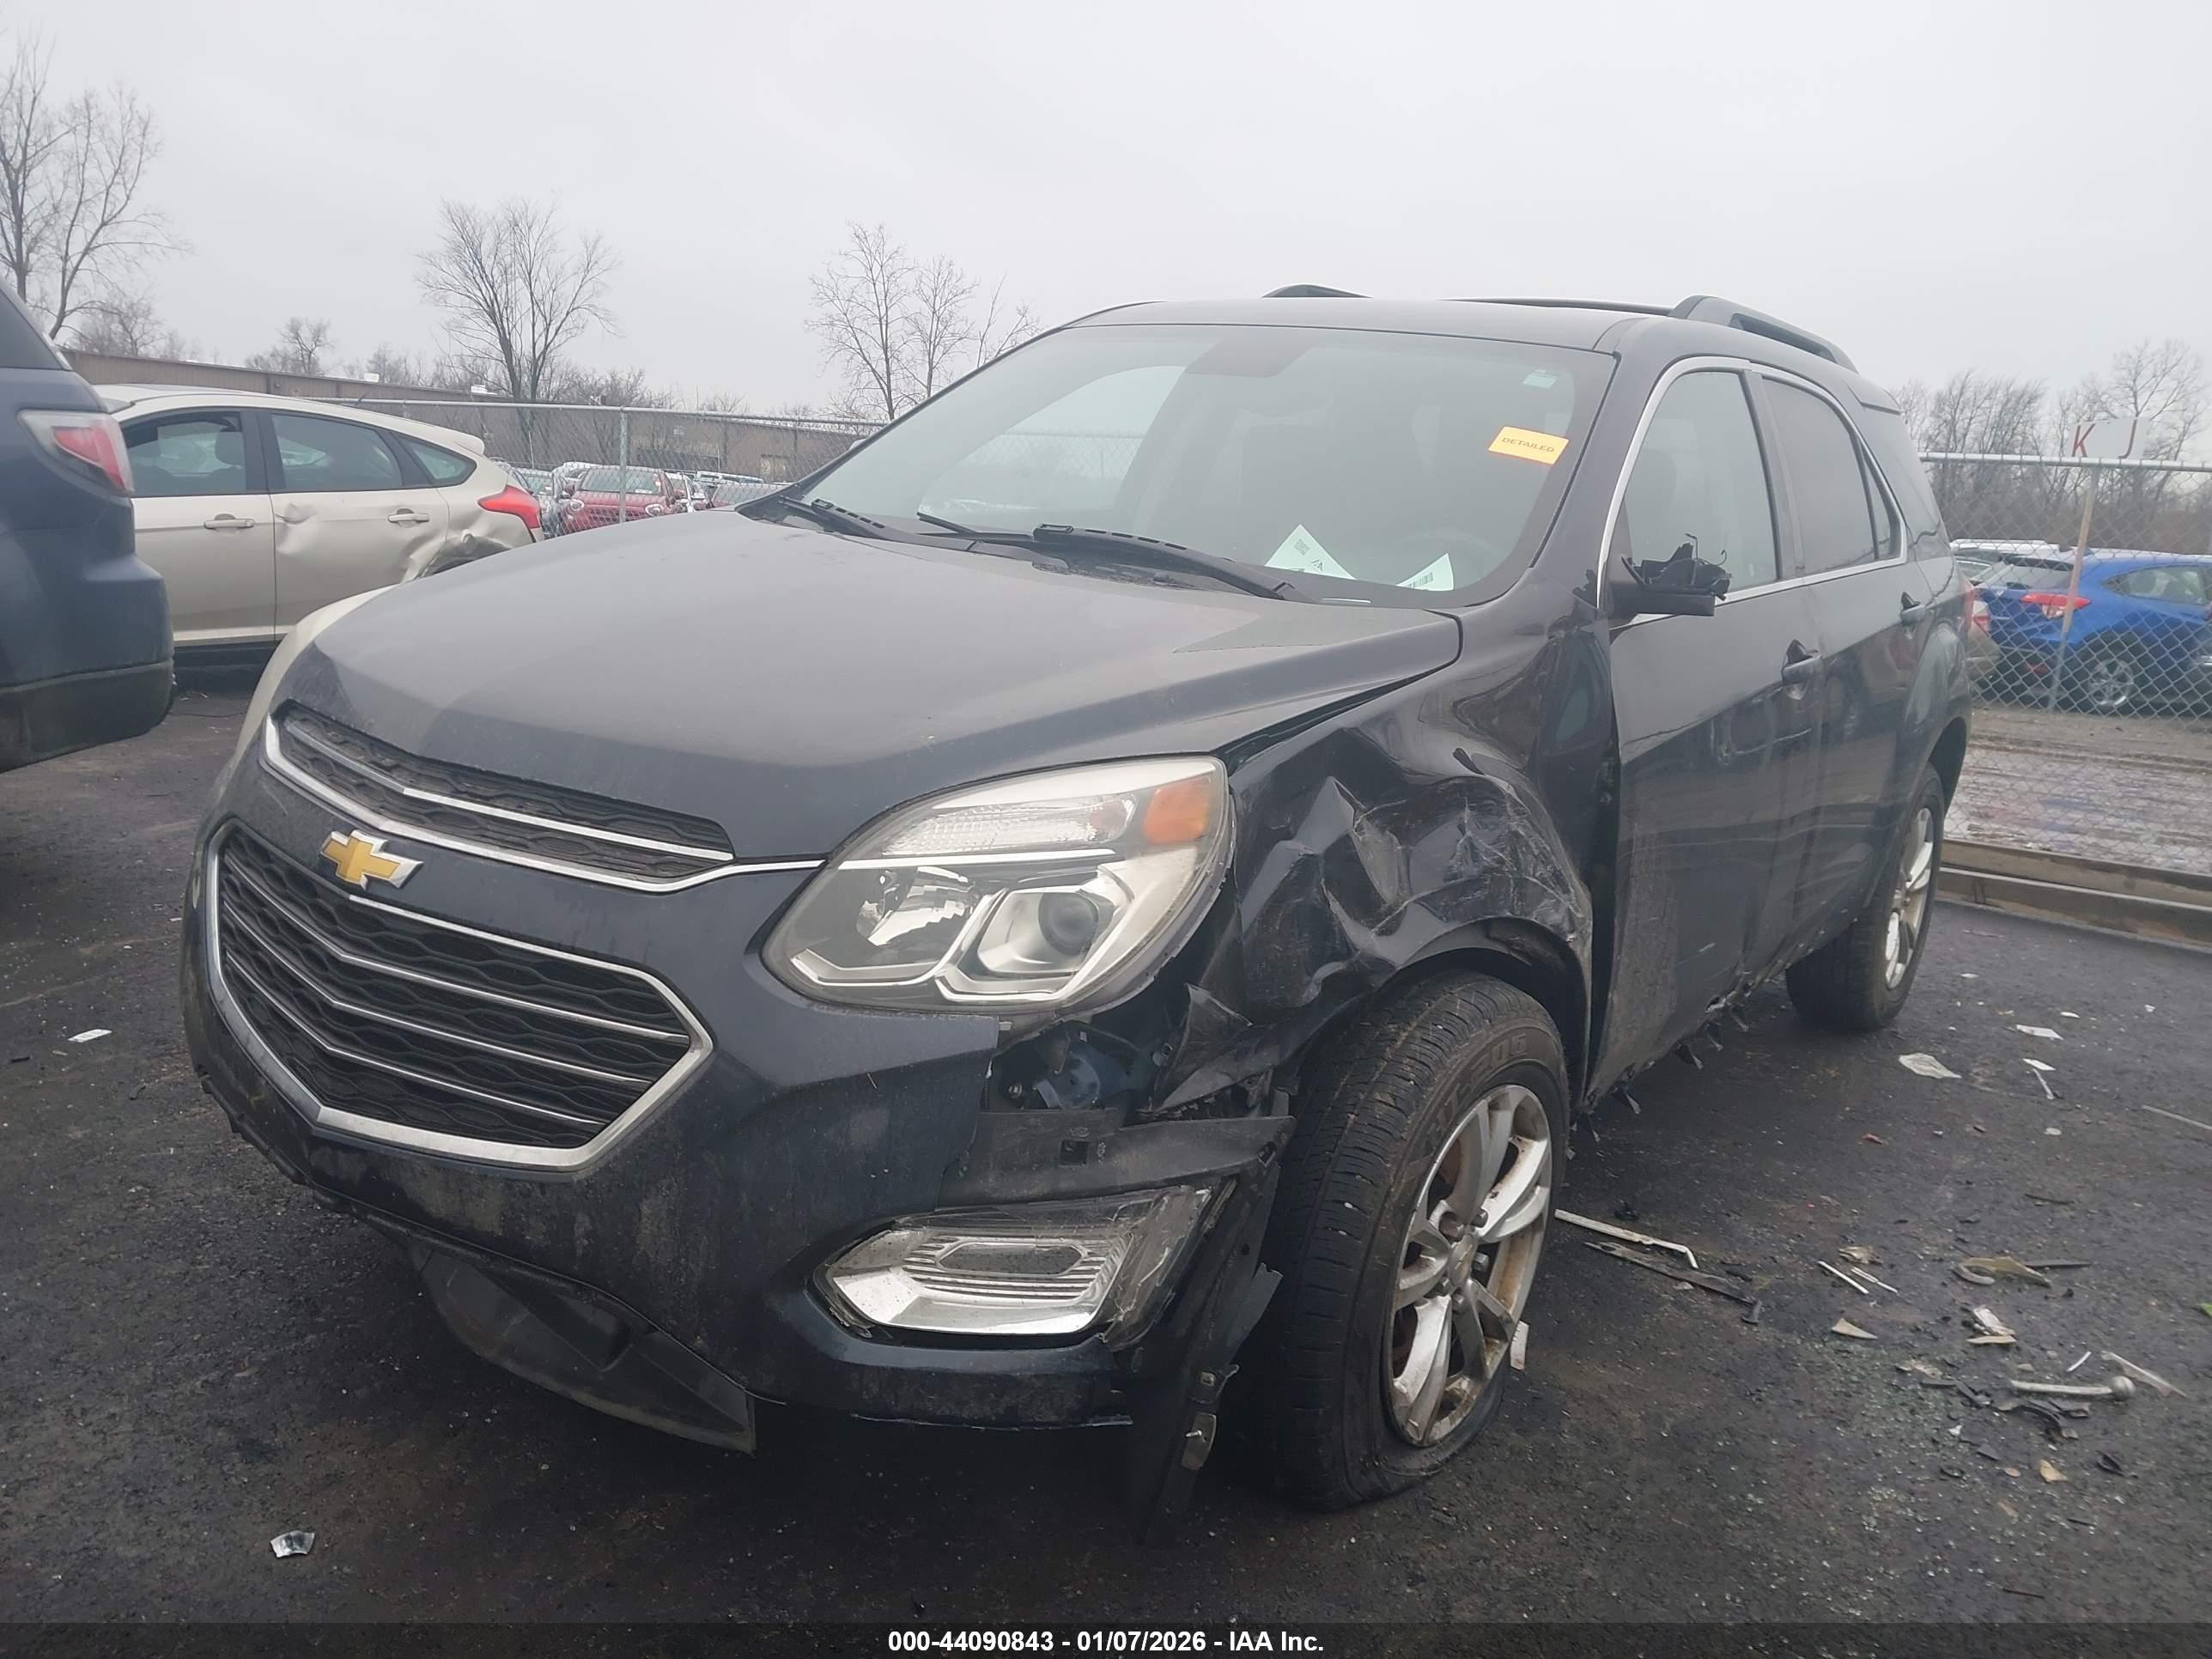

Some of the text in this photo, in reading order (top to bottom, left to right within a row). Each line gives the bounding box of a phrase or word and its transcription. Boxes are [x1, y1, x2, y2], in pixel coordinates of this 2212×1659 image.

[1502, 437, 1554, 453] DETAILED
[2071, 418, 2137, 459] K J
